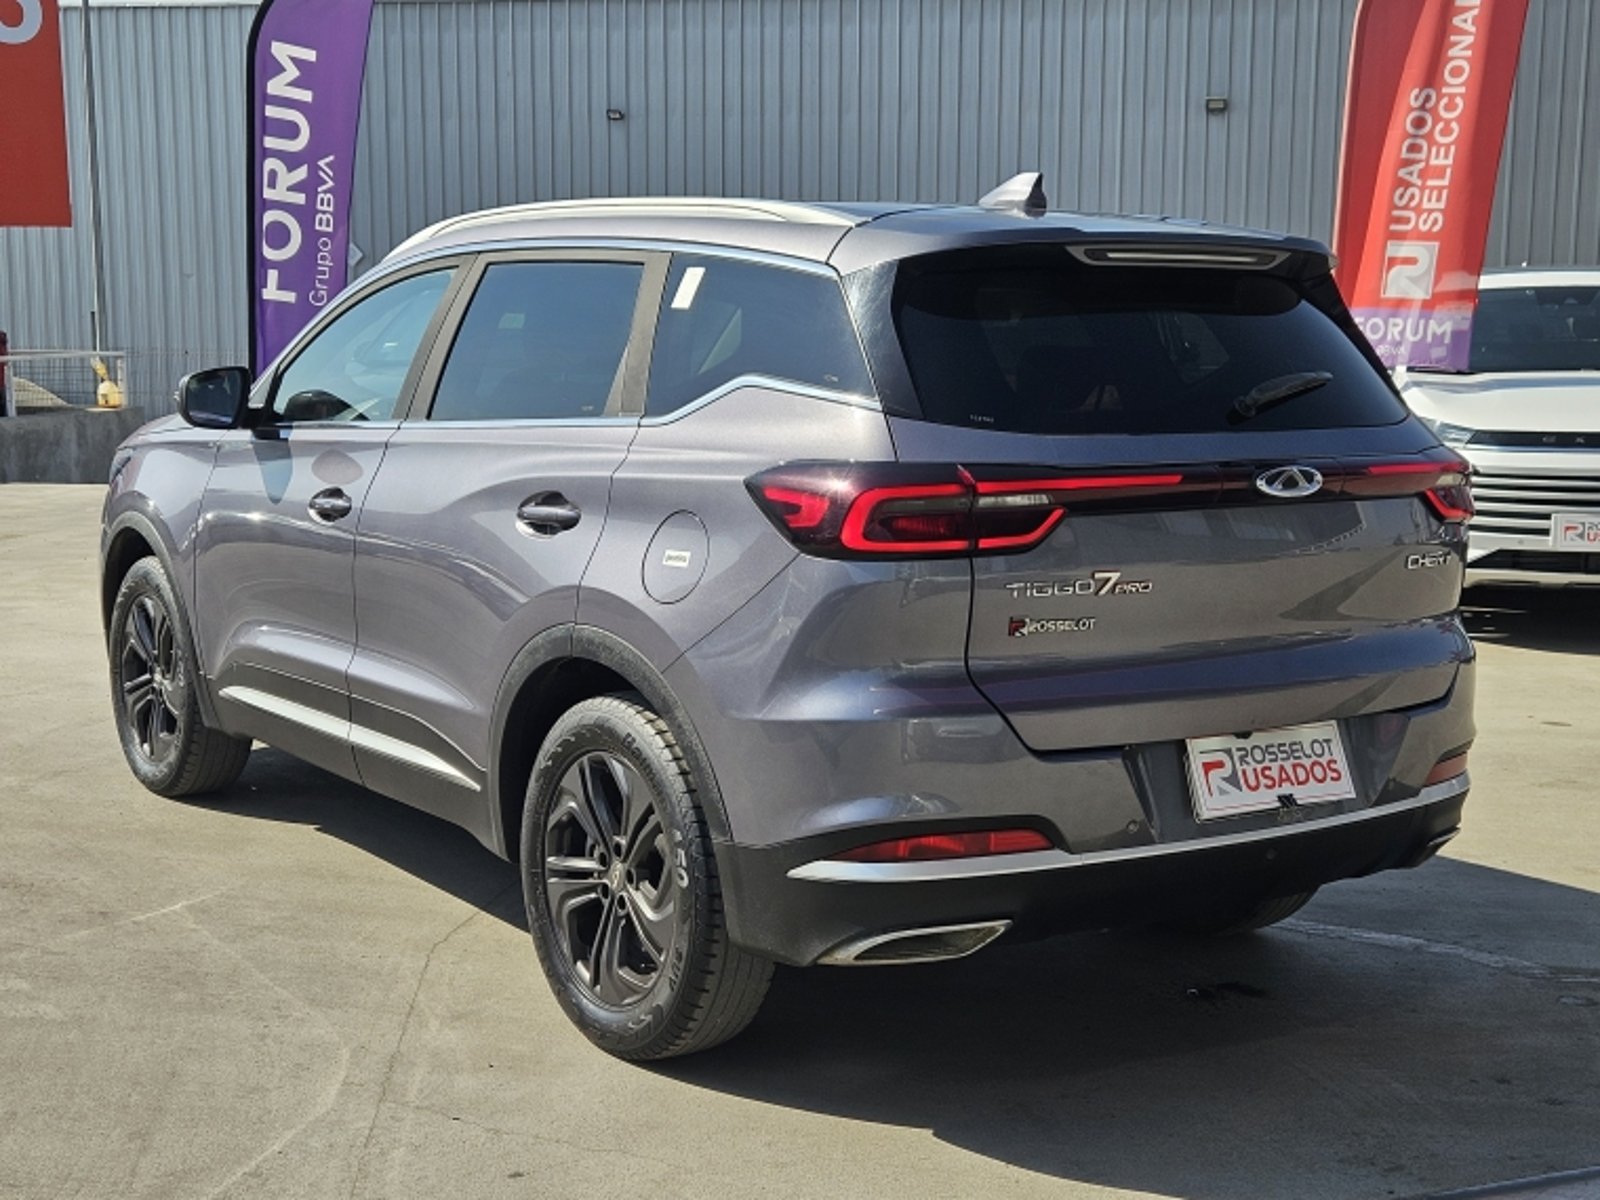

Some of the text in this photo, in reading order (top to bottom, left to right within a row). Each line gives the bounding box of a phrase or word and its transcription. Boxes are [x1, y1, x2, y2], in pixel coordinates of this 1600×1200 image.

[262, 40, 318, 304] FORUM
[1389, 87, 1437, 232] USADOS
[1418, 0, 1481, 234] SELECCIONA
[309, 154, 336, 307] Grupo BBVA
[1234, 738, 1333, 767] ROSSELOT
[1242, 759, 1342, 793] USADOS
